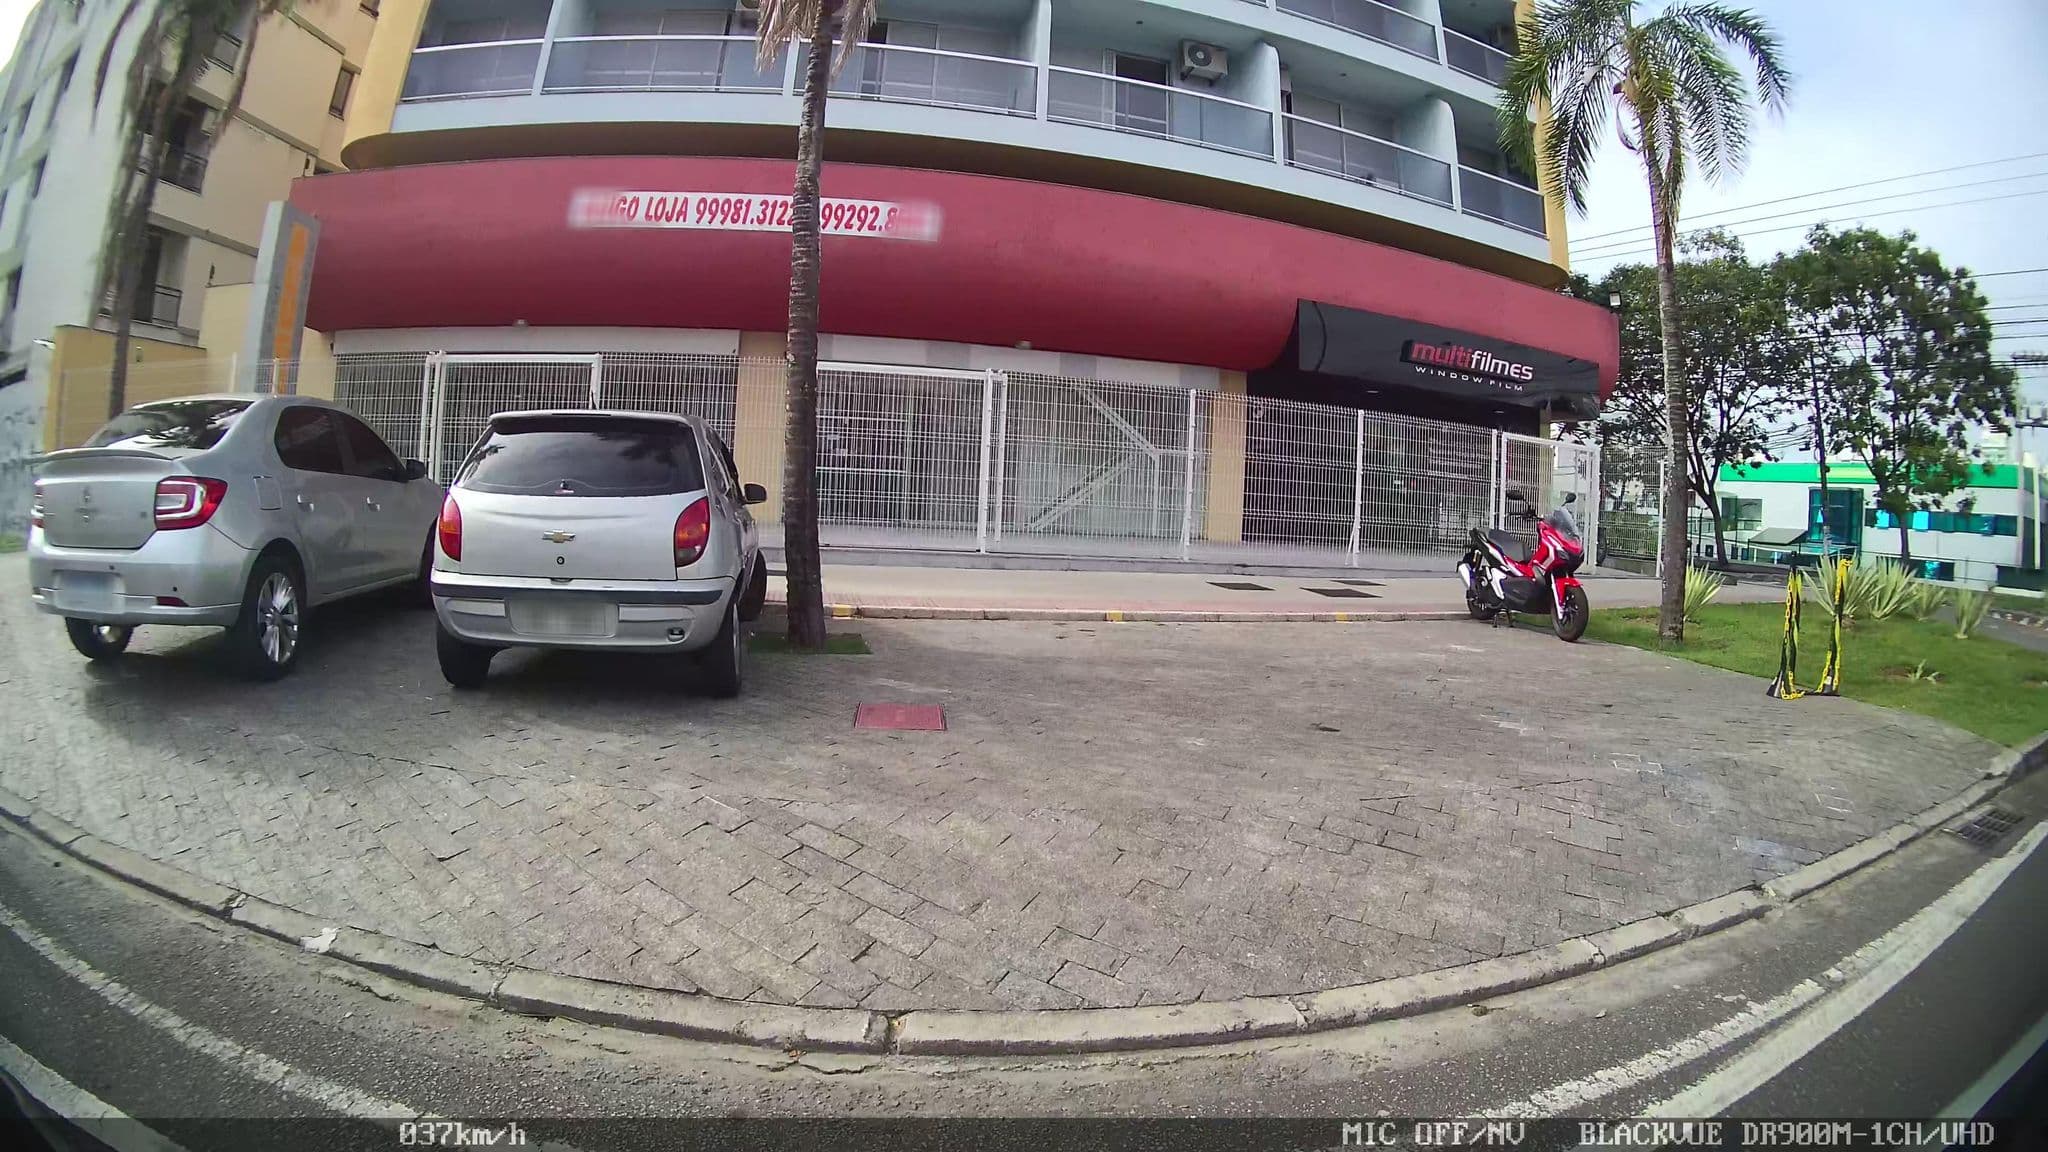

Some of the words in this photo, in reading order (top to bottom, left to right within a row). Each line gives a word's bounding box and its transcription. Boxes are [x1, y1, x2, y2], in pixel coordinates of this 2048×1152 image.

[645, 196, 688, 223] LOJA
[1415, 365, 1483, 384] WINDOW
[1489, 380, 1524, 392] FILM
